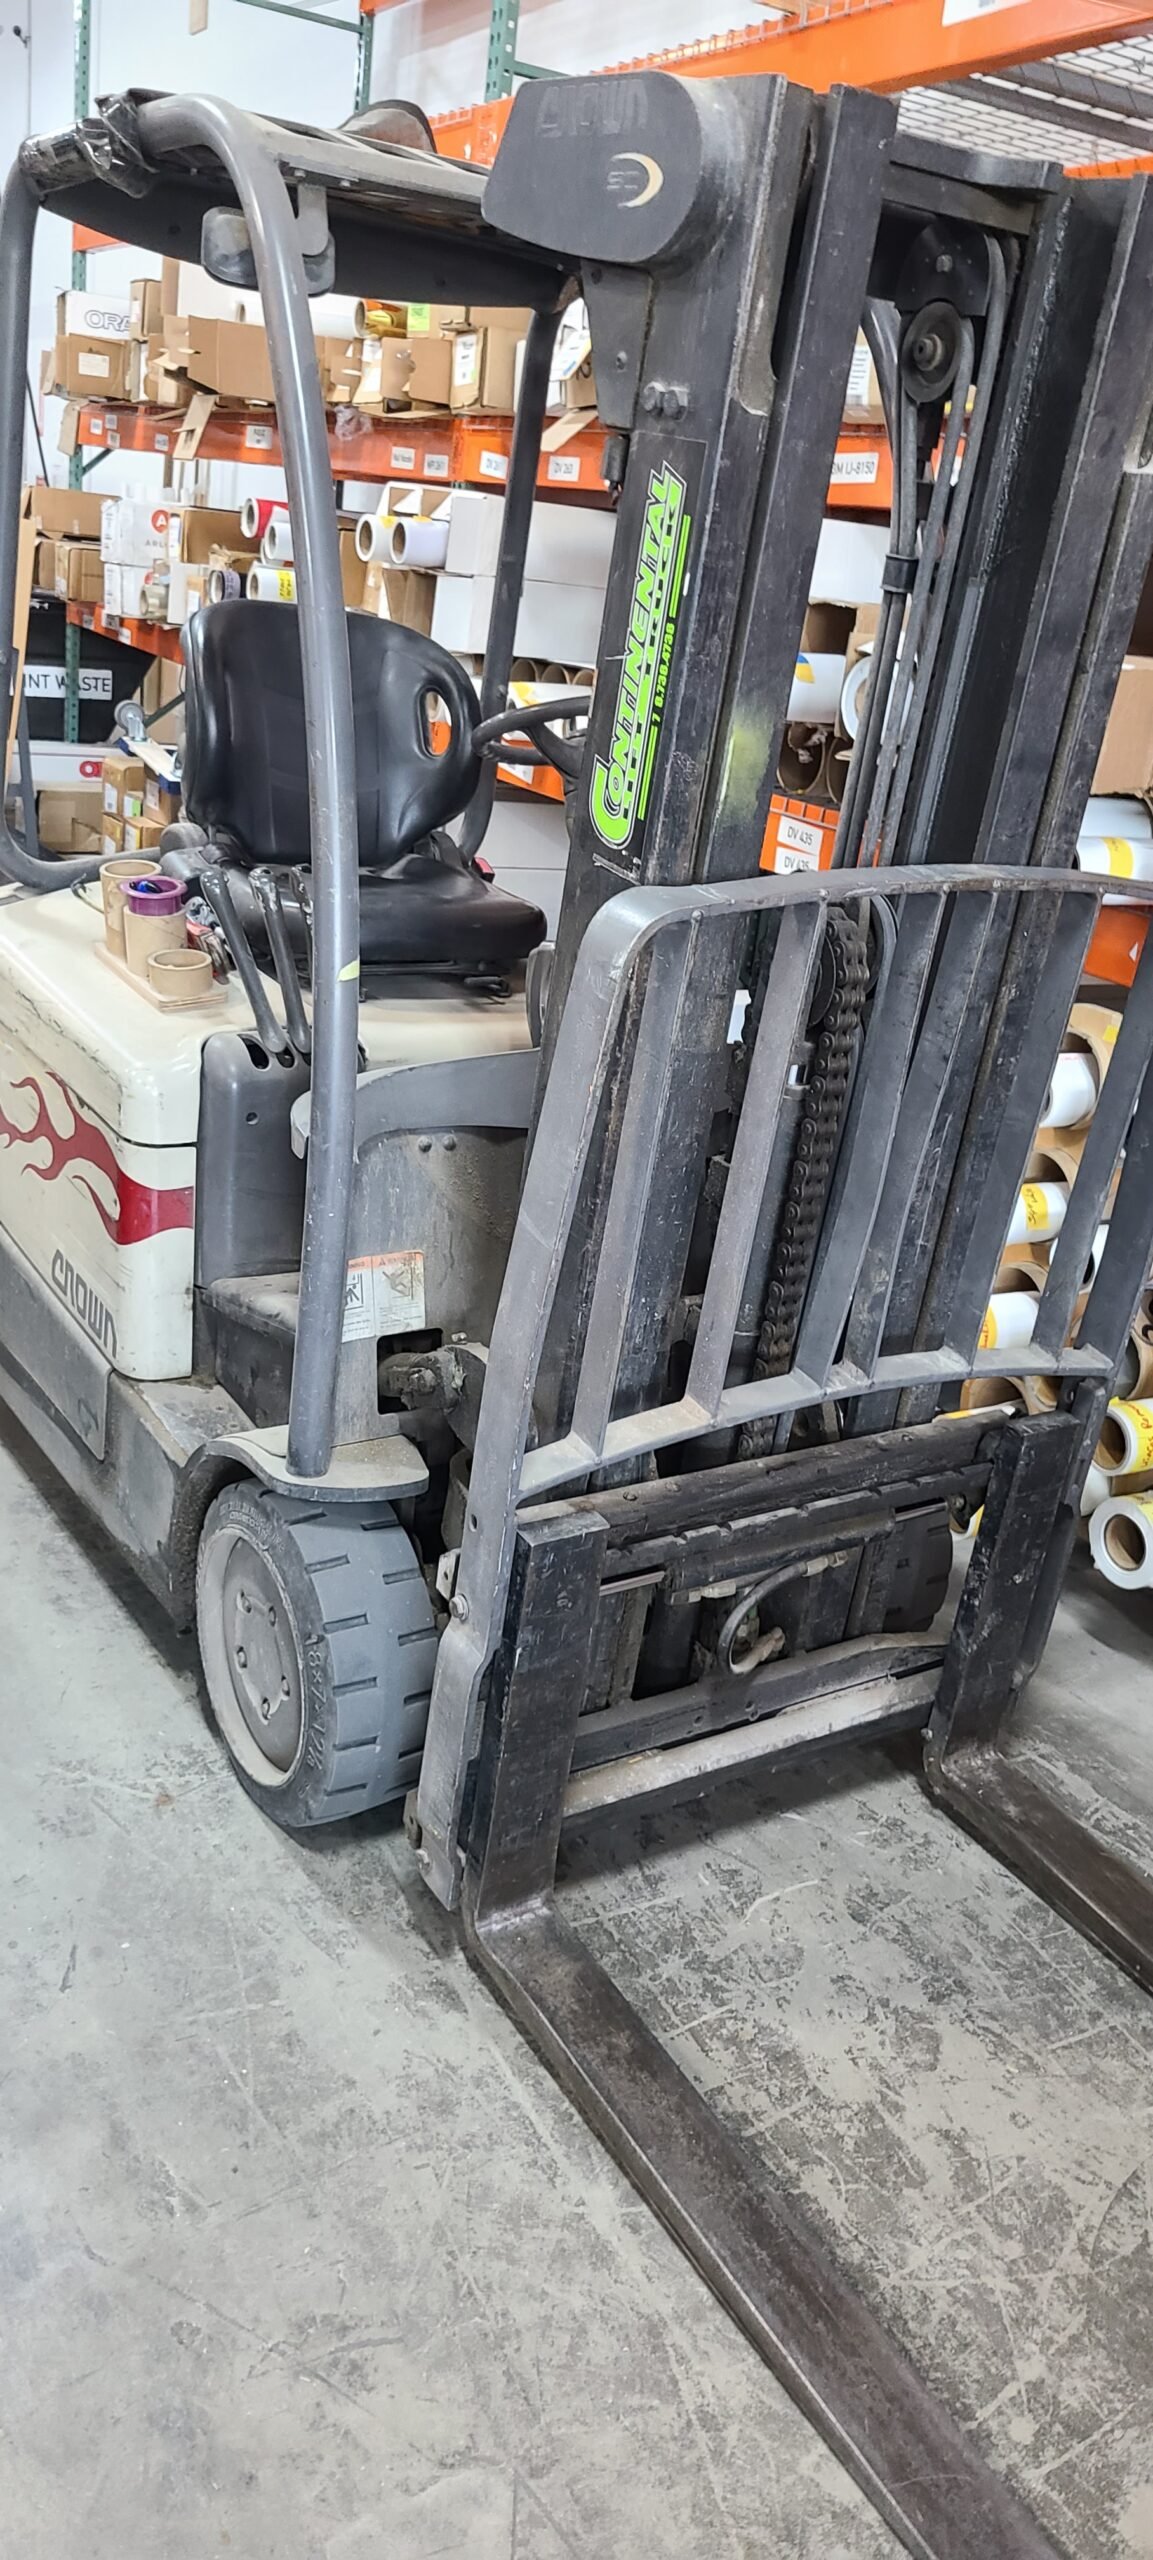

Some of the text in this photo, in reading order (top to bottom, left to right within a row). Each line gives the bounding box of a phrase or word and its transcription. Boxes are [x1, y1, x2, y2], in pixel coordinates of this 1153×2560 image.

[145, 539, 166, 549] ARL
[590, 463, 686, 848] CONTINENTAL
[23, 673, 112, 693] INT WSTE
[787, 826, 799, 840] DV
